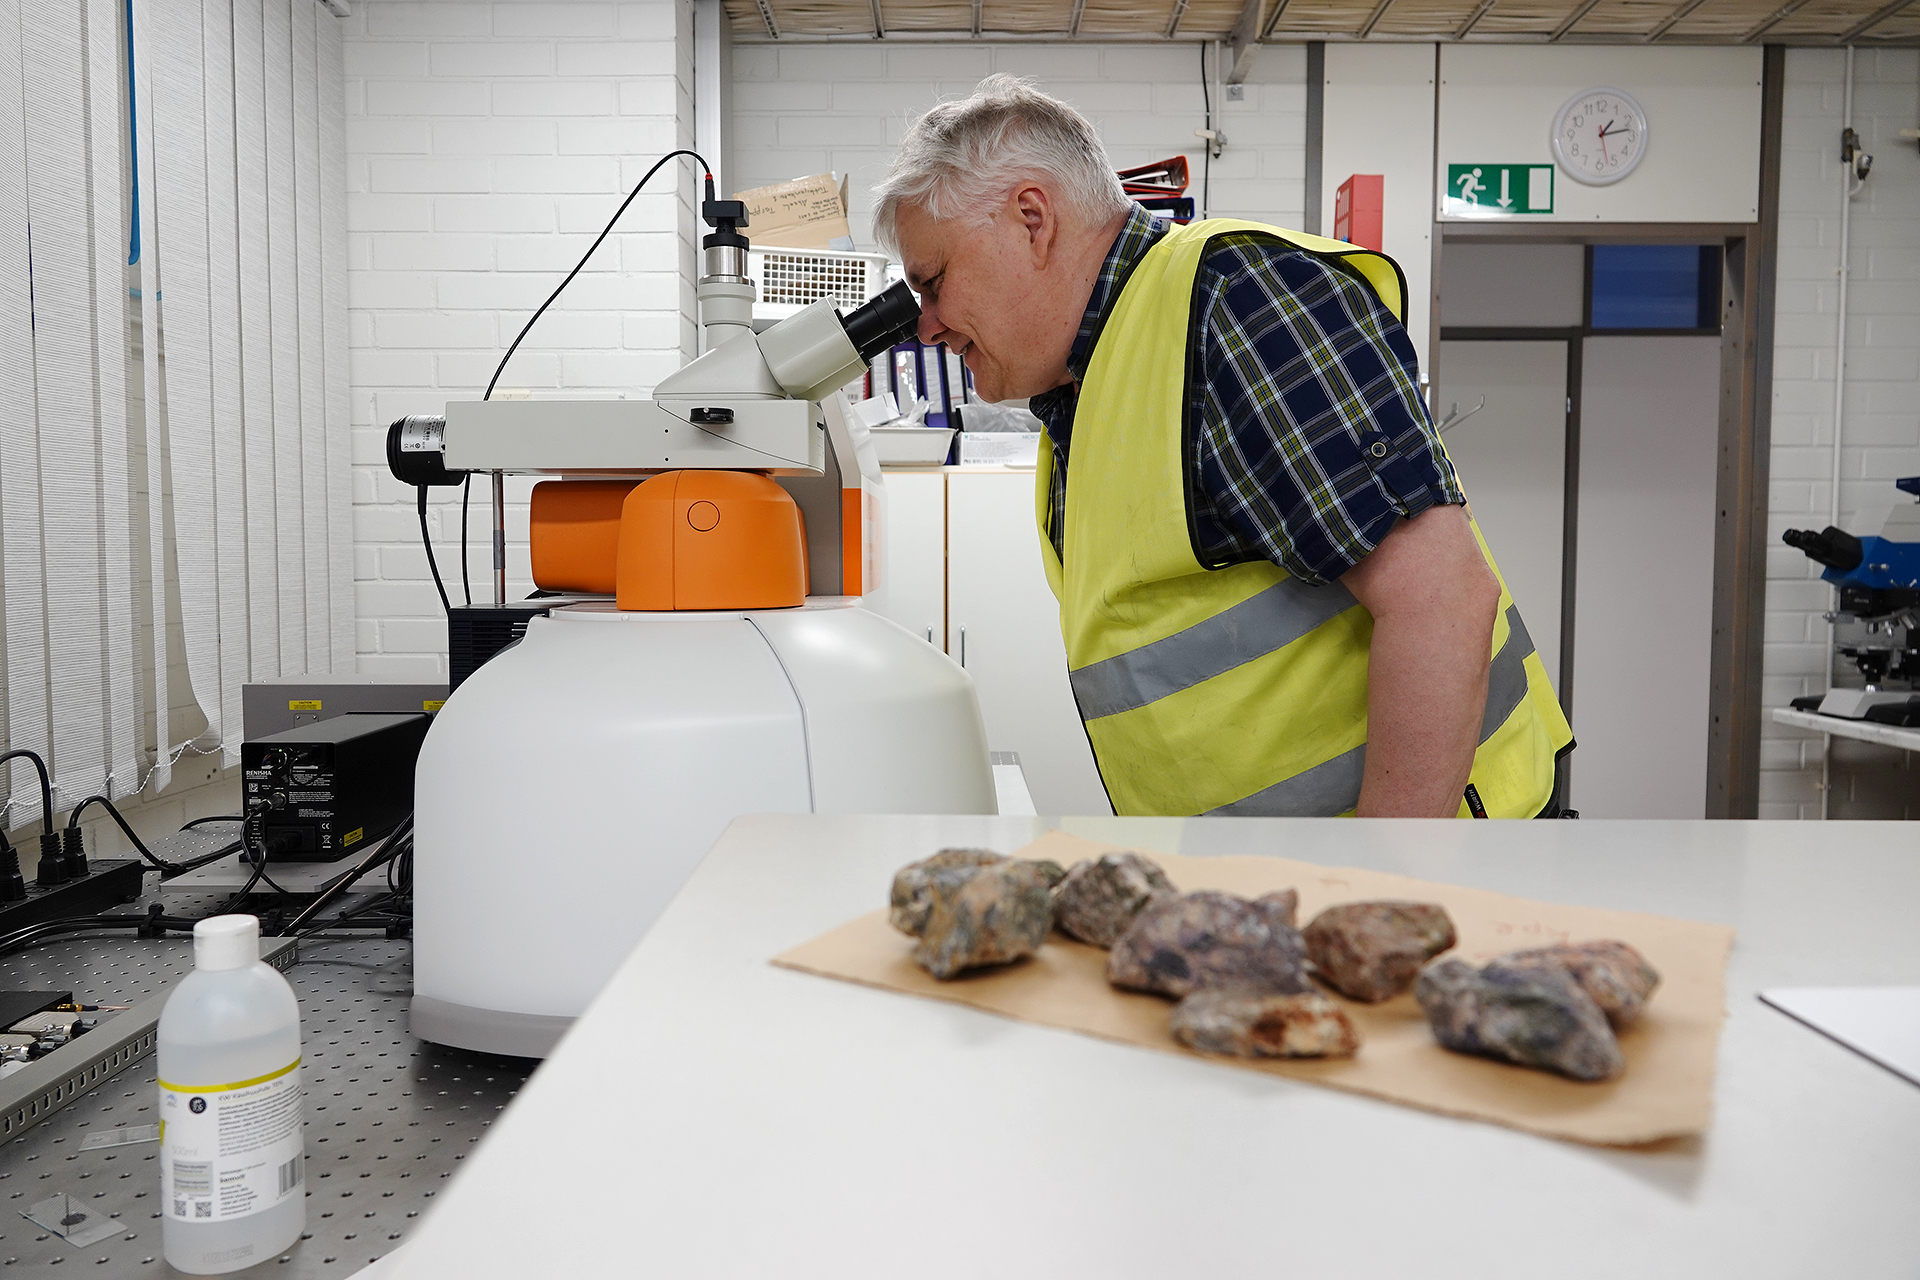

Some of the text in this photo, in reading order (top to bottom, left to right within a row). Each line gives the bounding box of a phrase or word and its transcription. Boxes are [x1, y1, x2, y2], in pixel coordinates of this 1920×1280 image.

[1584, 104, 1593, 115] 11
[1596, 100, 1608, 113] 12
[1614, 104, 1619, 115] 1
[1573, 115, 1584, 128] 10
[1624, 114, 1632, 127] 2
[1567, 128, 1575, 141] 9
[1627, 129, 1636, 142] 3
[1571, 143, 1579, 157] 8
[1621, 144, 1629, 156] 4
[1582, 154, 1588, 165] 7
[1595, 159, 1604, 171] 6
[1610, 154, 1618, 167] 5
